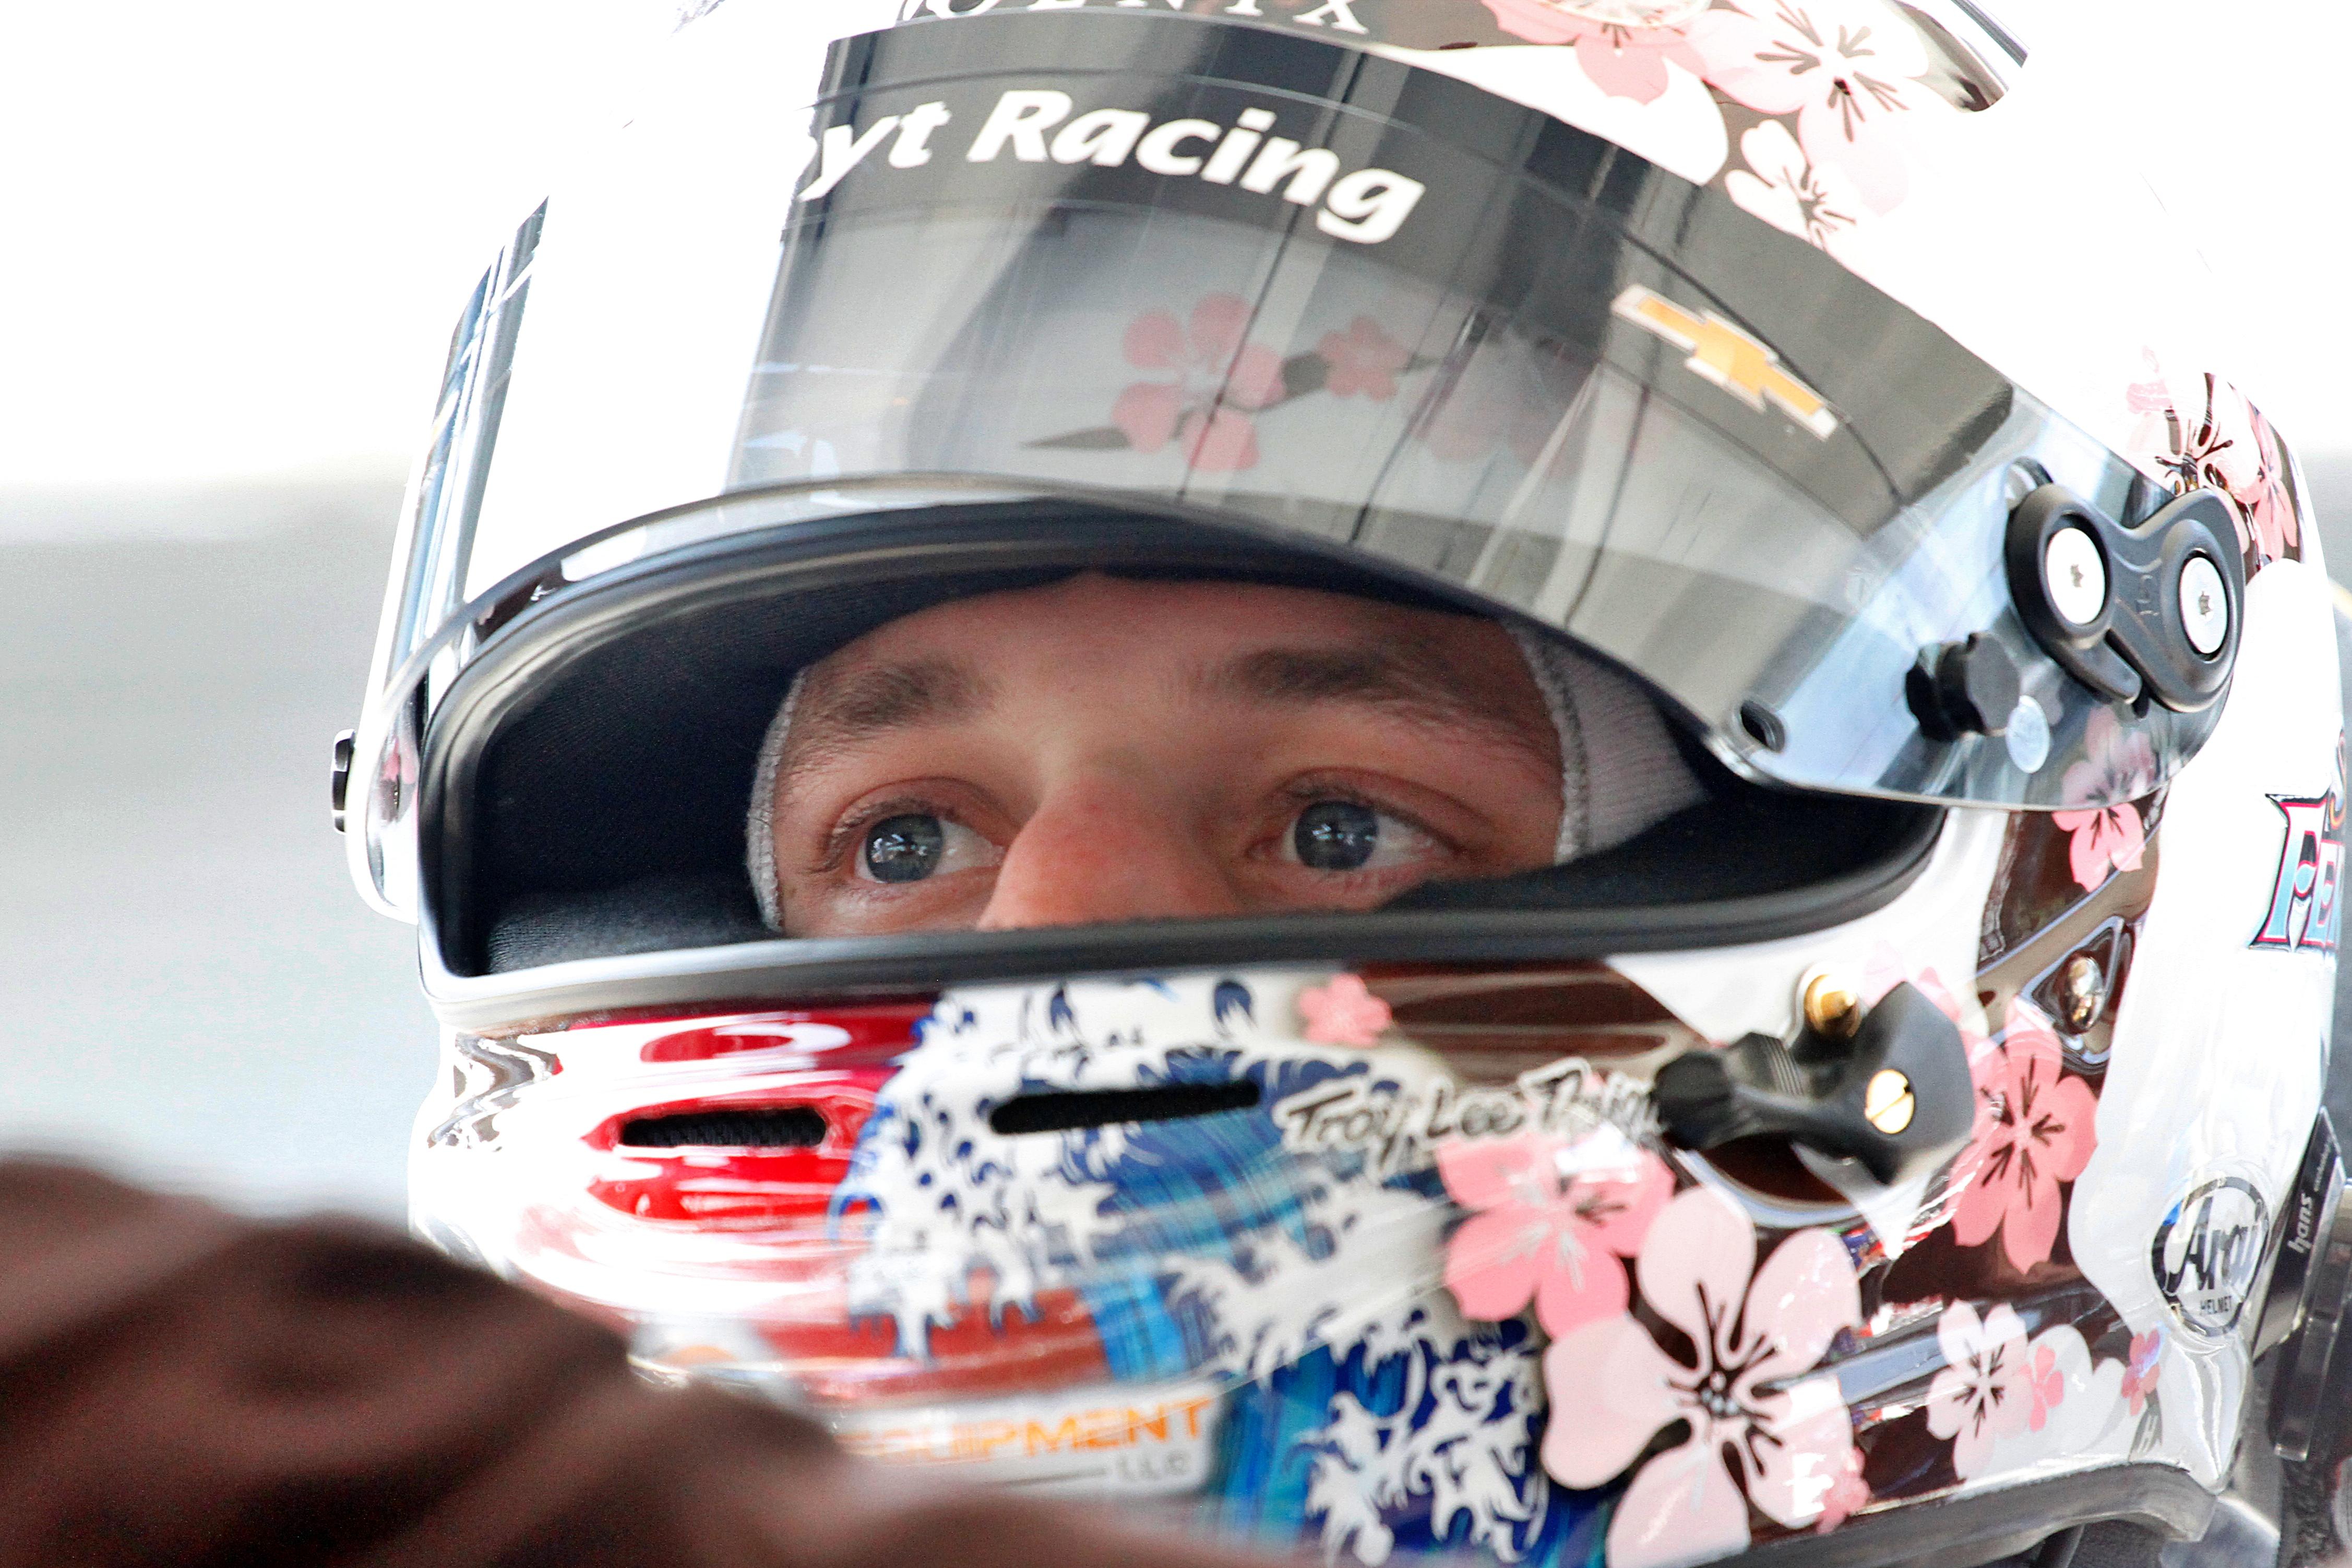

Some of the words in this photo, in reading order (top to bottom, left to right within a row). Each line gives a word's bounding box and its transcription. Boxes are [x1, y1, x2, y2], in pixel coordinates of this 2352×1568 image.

[796, 100, 952, 202] yt
[966, 90, 1426, 244] Racing
[2249, 793, 2343, 953] FE
[1281, 1086, 1410, 1172] Troy
[1426, 1084, 1526, 1142] Lee
[2287, 1192, 2313, 1254] hans
[2200, 1295, 2233, 1315] HELMET
